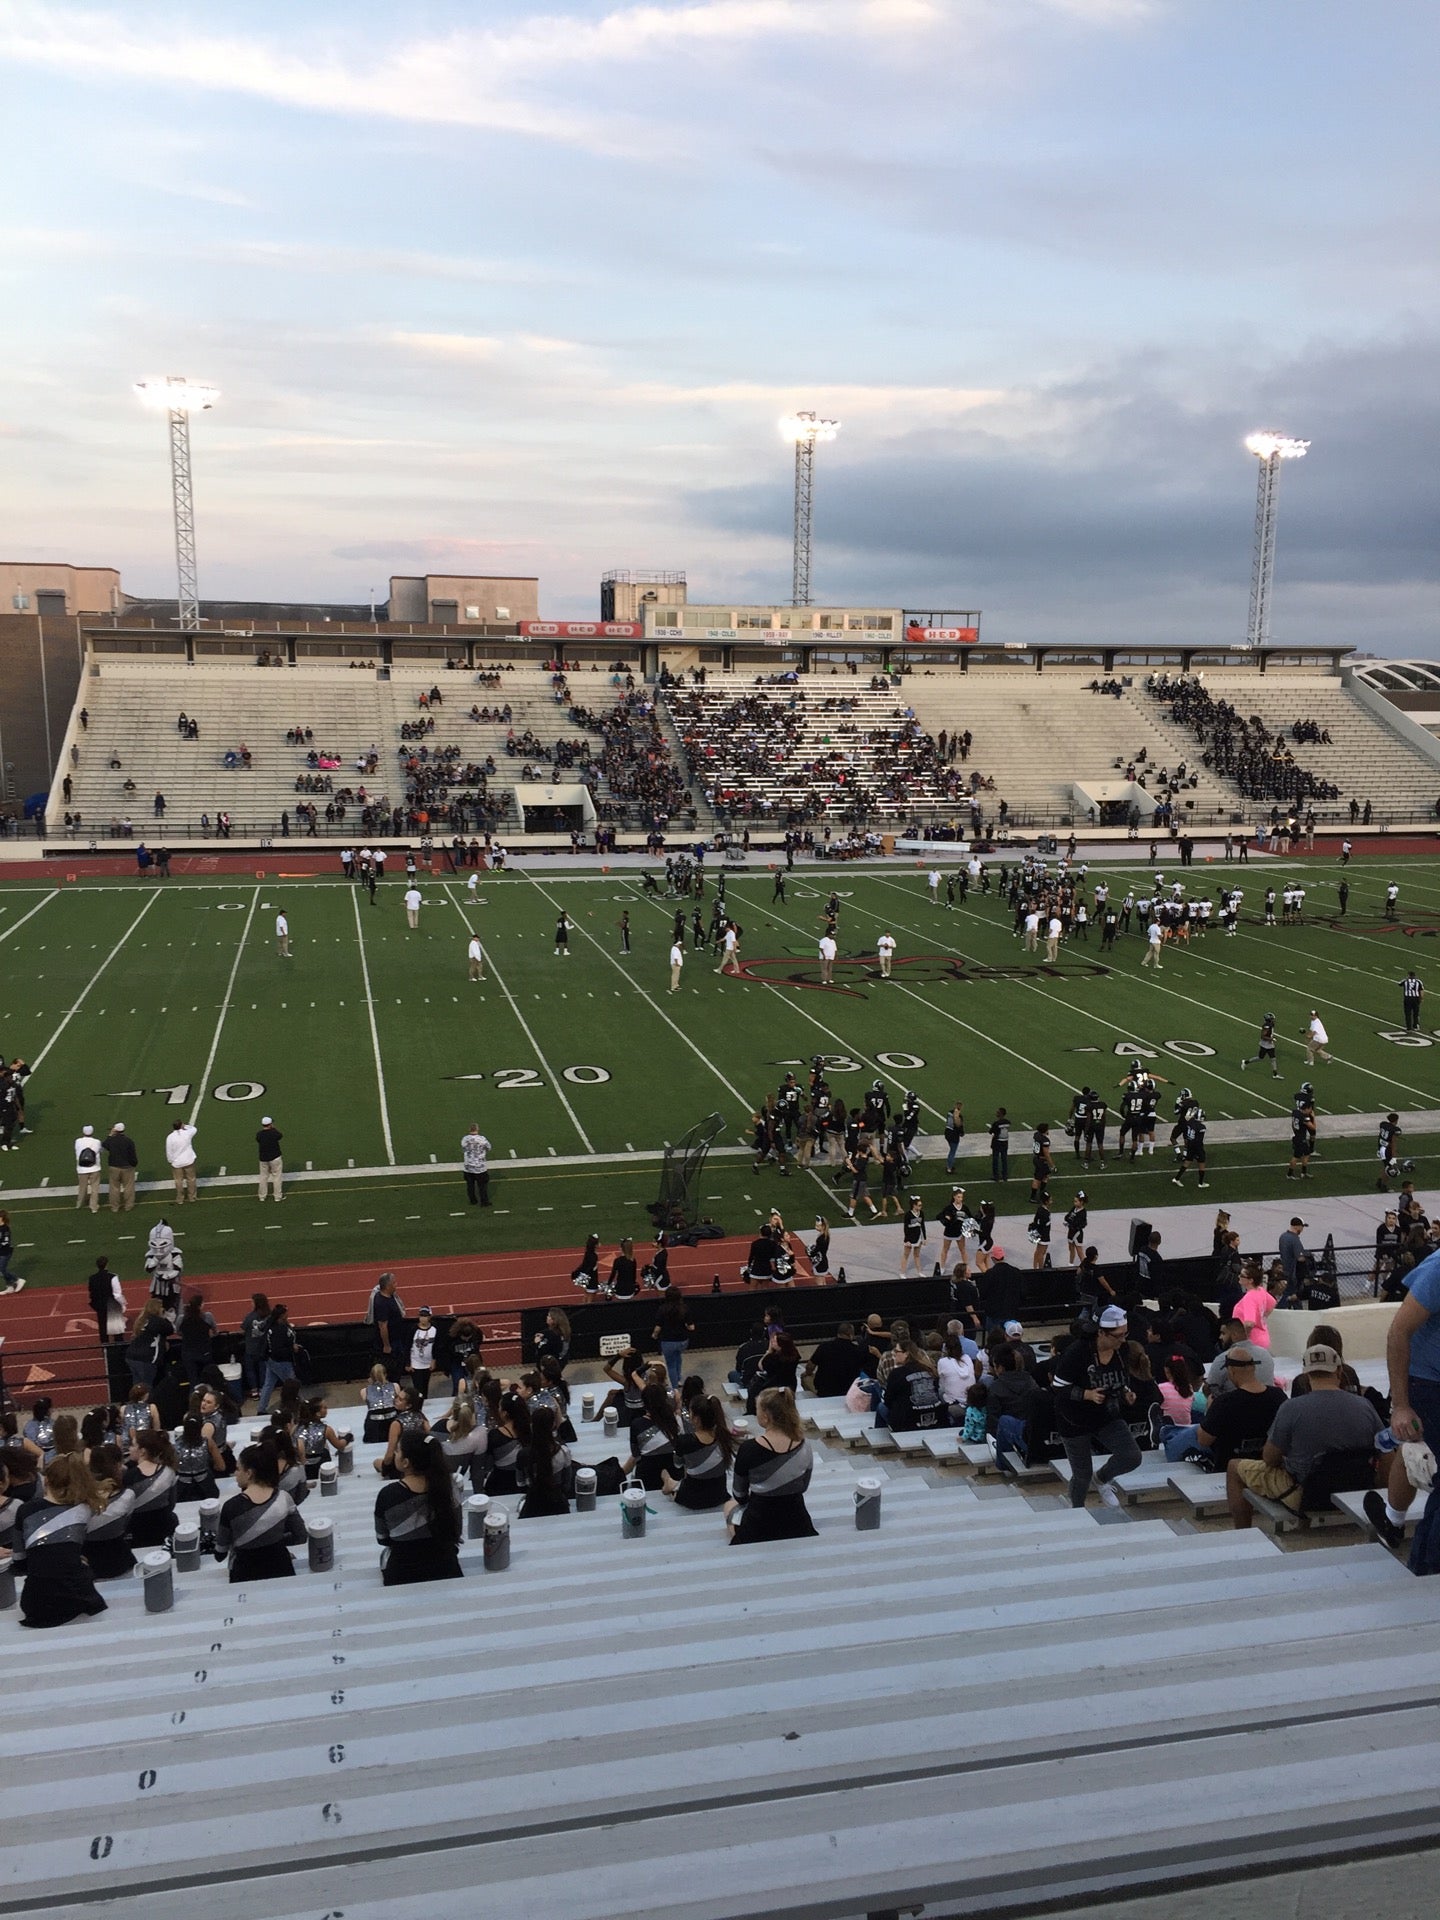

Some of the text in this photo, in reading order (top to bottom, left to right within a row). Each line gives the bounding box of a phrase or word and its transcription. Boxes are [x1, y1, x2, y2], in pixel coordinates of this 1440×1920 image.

[1113, 1040, 1217, 1058] 40
[822, 1052, 927, 1072] 30
[492, 1065, 612, 1088] 20
[153, 1081, 267, 1105] 10
[1091, 1108, 1105, 1120] 17
[331, 1690, 344, 1705] 6
[328, 1744, 344, 1763] 6
[138, 1769, 157, 1790] 0
[322, 1803, 342, 1824] 6
[89, 1835, 114, 1860] 0
